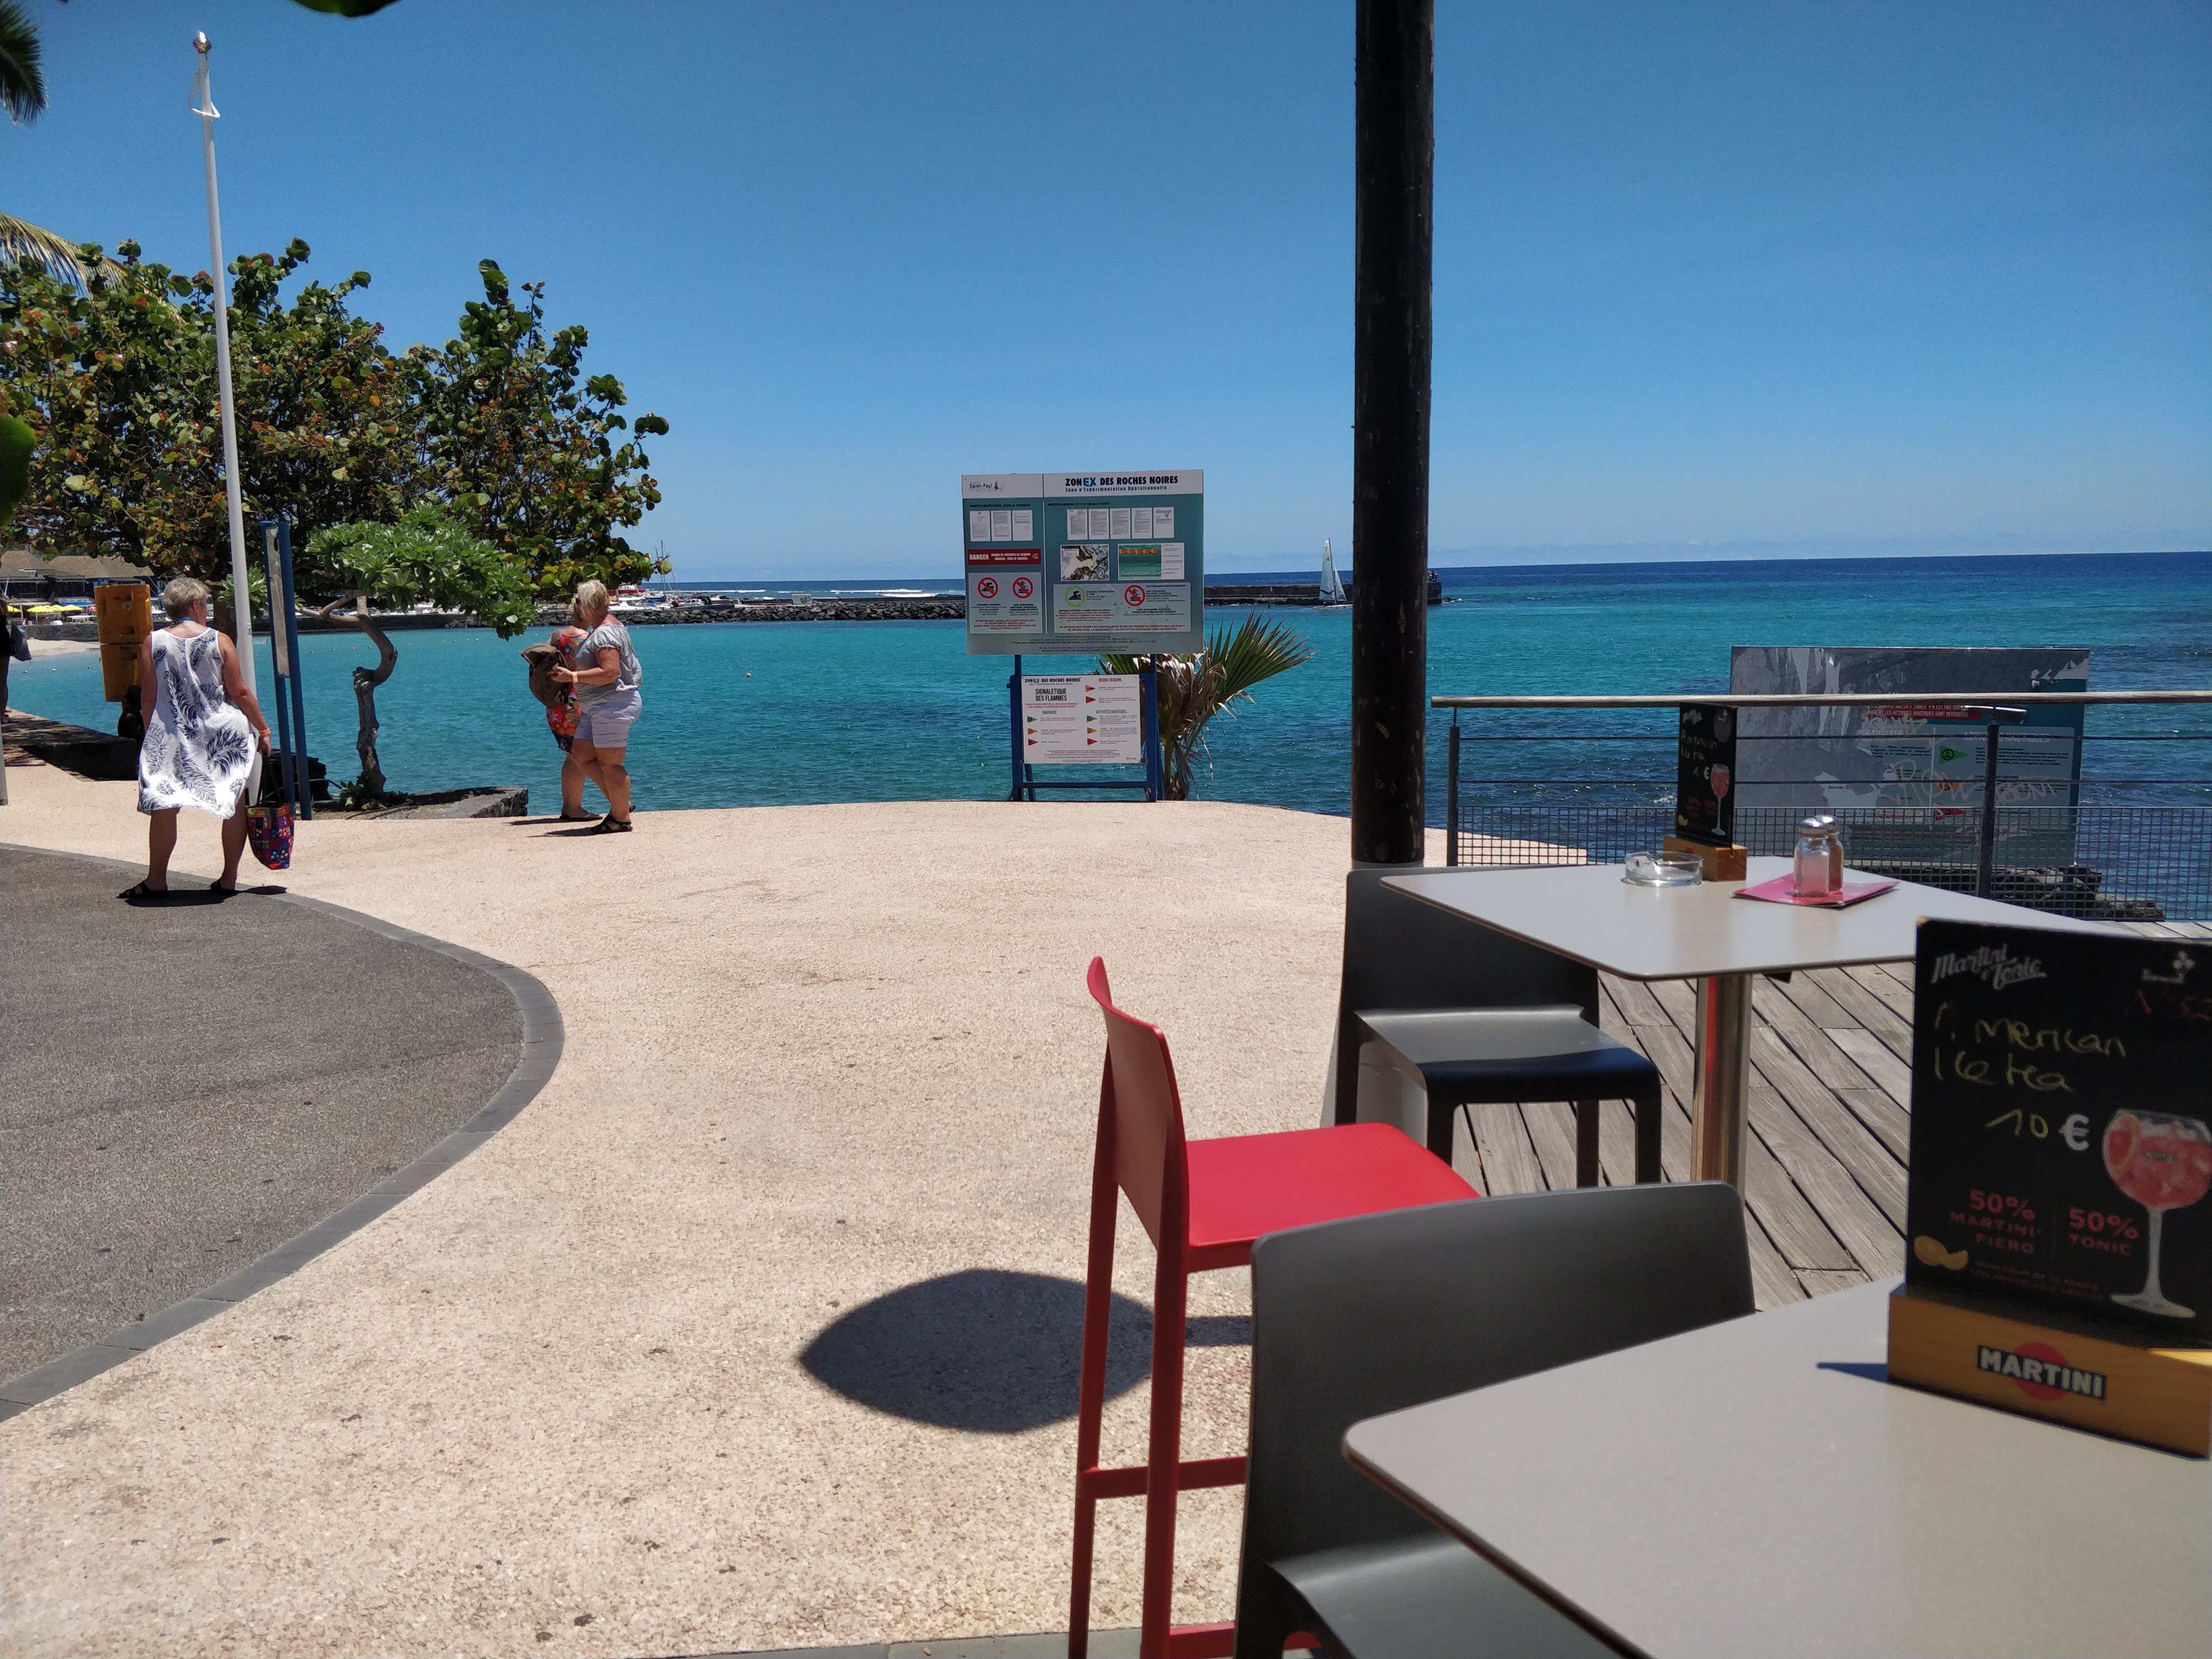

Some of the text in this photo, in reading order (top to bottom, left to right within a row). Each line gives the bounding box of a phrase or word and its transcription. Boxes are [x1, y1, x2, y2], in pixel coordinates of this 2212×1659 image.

[1065, 476, 1178, 487] ZONEX DES ROCHES NOIRES
[1930, 943, 2008, 984] Martini
[1985, 1108, 2090, 1151] 10 €
[1970, 1189, 2139, 1239] 50% 50%
[2069, 1233, 2131, 1255] TONIC
[1981, 1347, 2103, 1398] MARTINI
